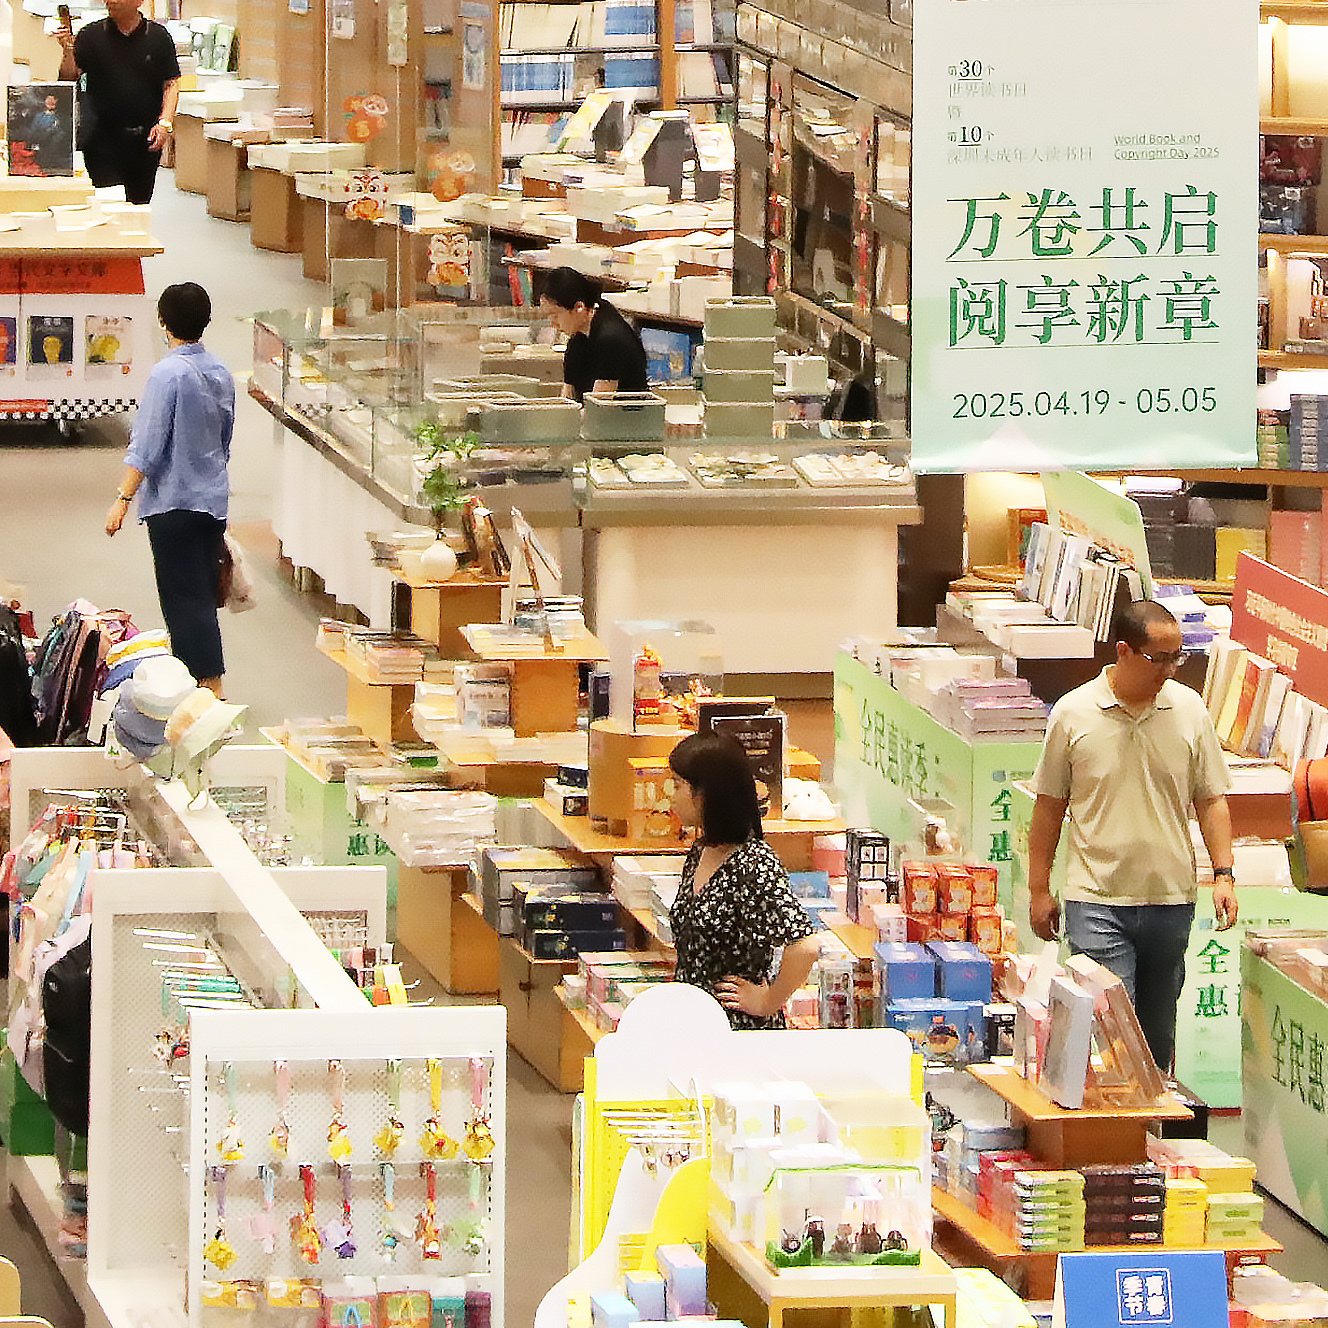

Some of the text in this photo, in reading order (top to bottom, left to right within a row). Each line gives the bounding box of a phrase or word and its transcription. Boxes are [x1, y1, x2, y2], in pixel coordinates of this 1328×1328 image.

[946, 185, 1219, 259] 万卷共启
[949, 271, 1220, 346] 阅享新章
[953, 390, 1109, 418] 2025.04.19
[1136, 388, 1217, 413] 05.05
